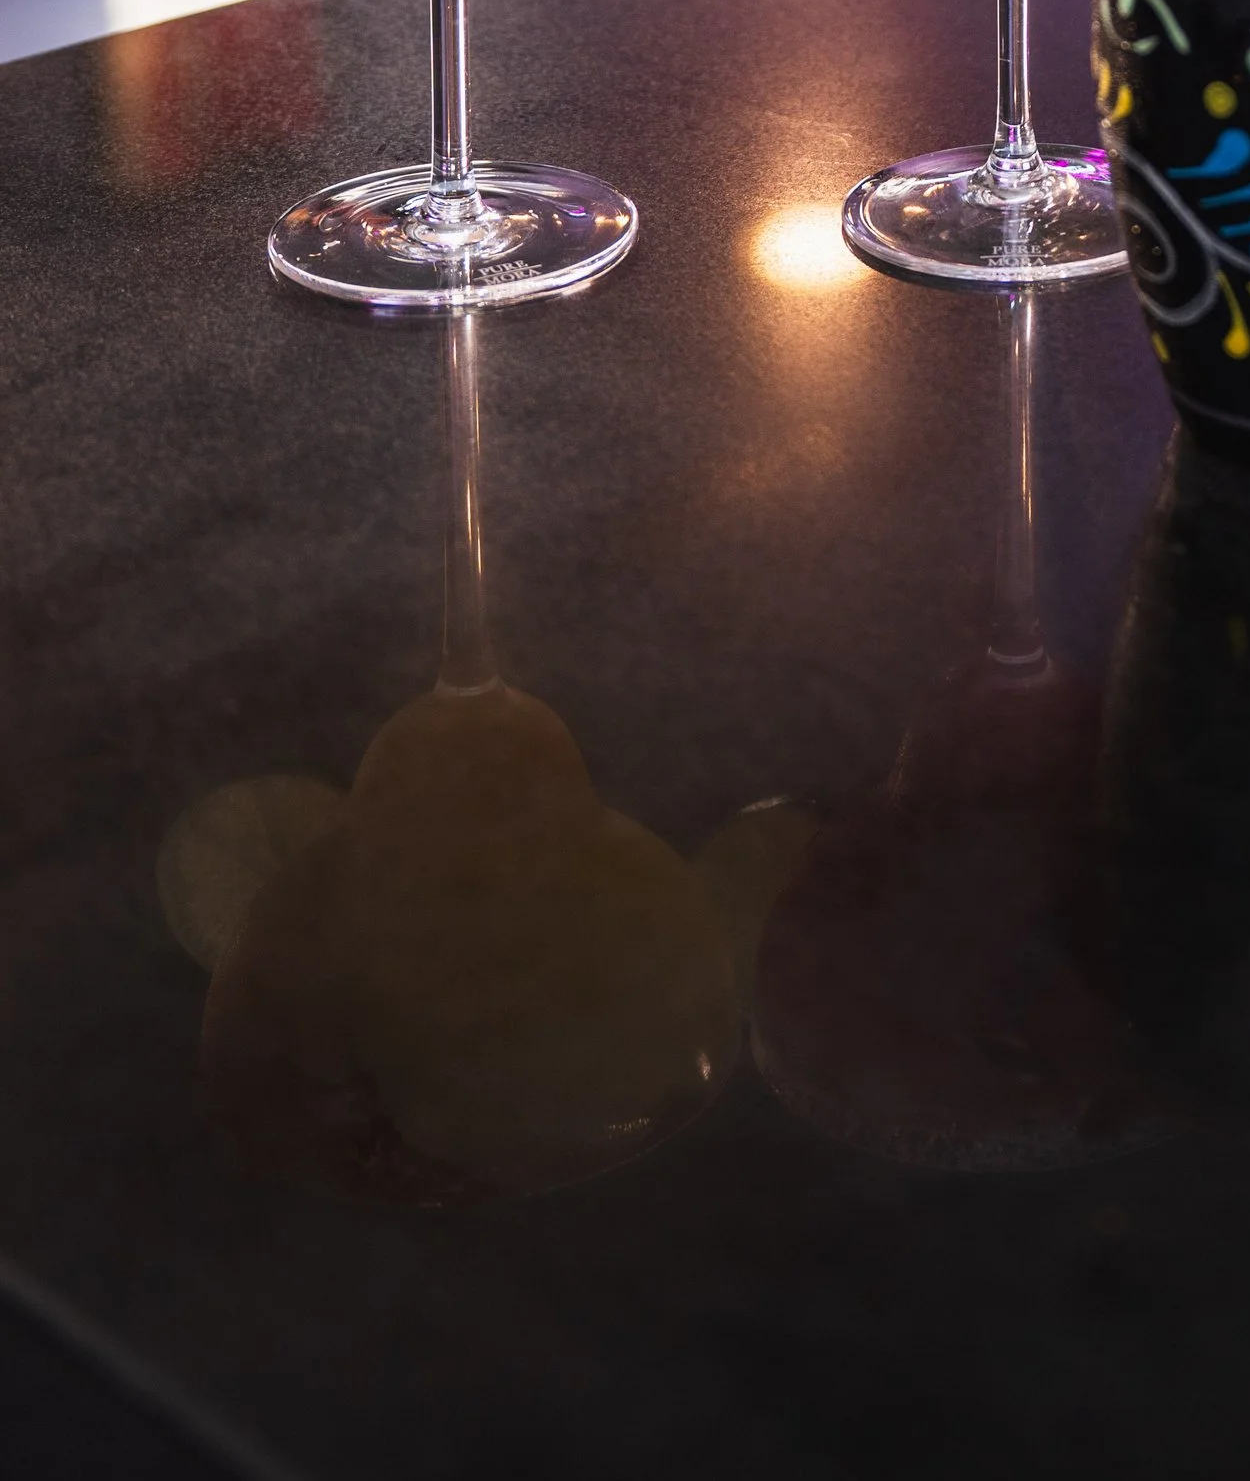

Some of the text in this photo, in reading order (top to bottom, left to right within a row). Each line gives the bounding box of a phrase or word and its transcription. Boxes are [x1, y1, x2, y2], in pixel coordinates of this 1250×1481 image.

[992, 245, 1042, 255] PURE
[478, 260, 528, 276] PURE
[988, 257, 1045, 267] MORA
[484, 268, 542, 286] MORA
